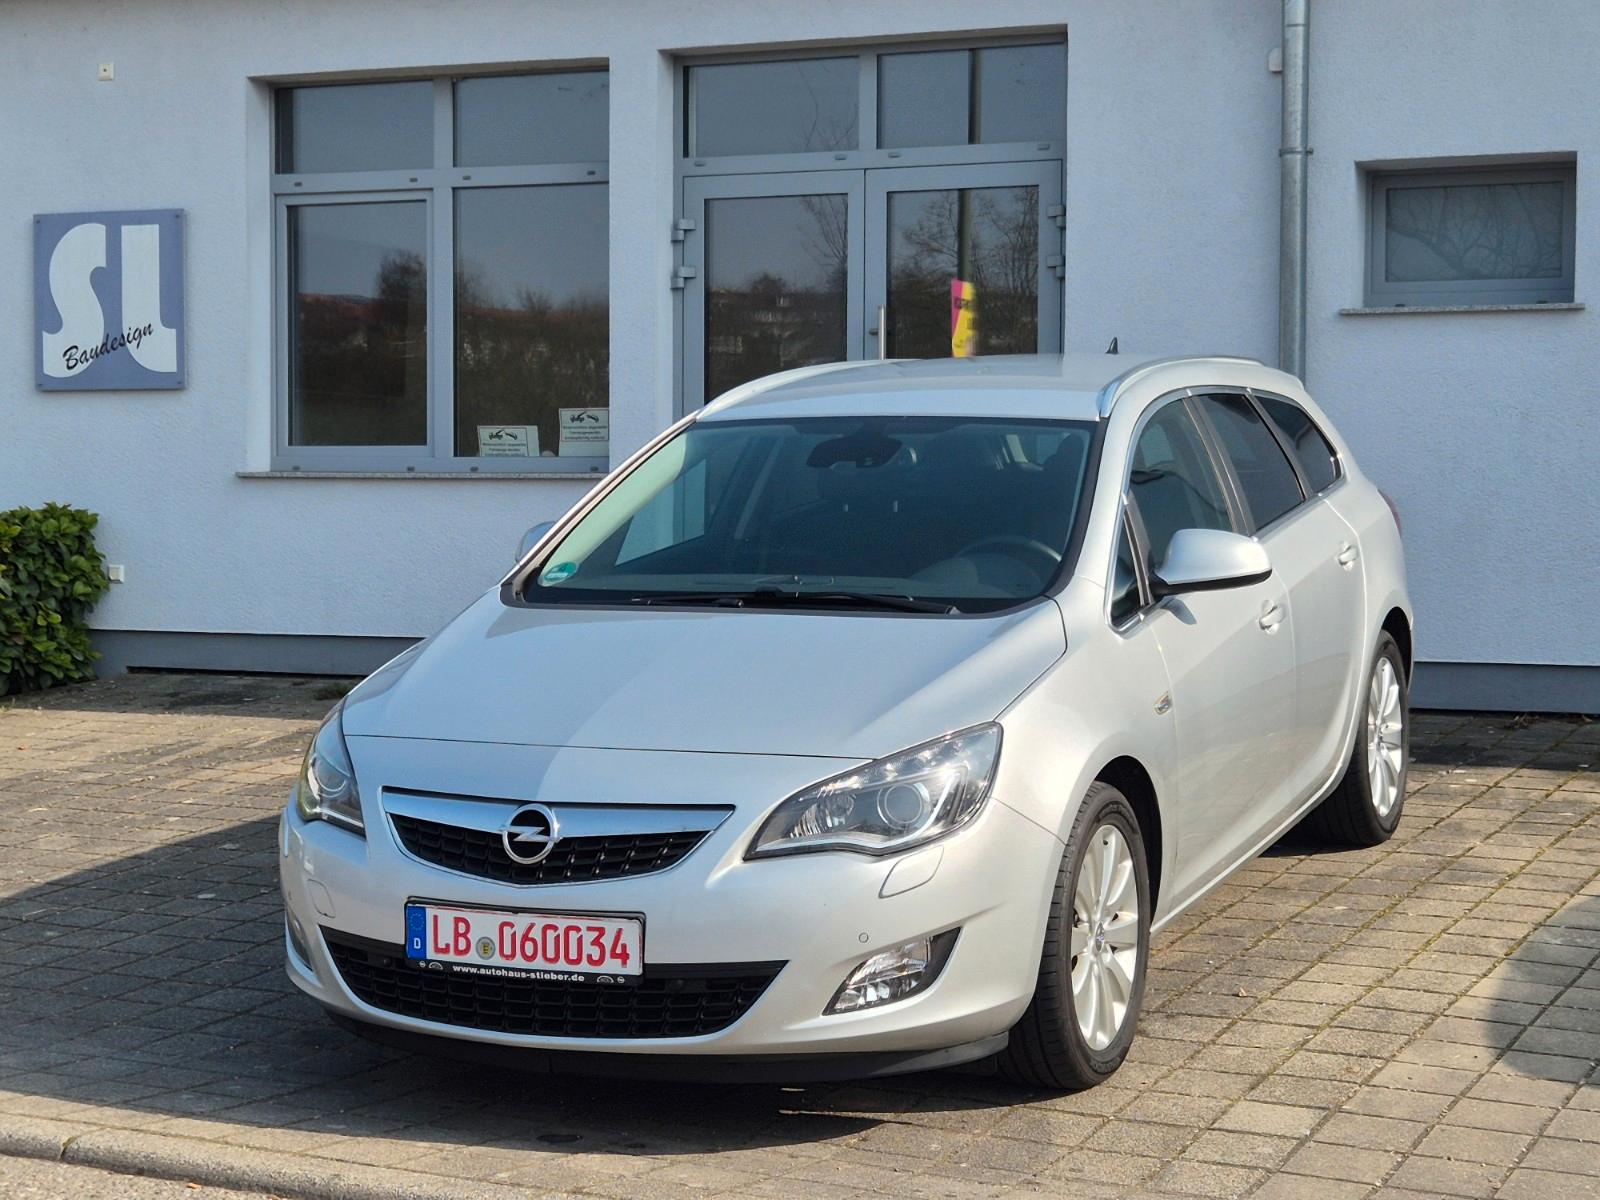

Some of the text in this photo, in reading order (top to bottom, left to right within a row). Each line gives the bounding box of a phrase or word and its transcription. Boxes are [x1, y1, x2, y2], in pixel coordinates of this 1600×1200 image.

[42, 222, 177, 378] SL
[62, 323, 154, 370] Baudesign
[413, 937, 422, 950] D
[432, 914, 630, 968] LB 060034
[453, 965, 585, 982] www.autohaus-stieber.de
